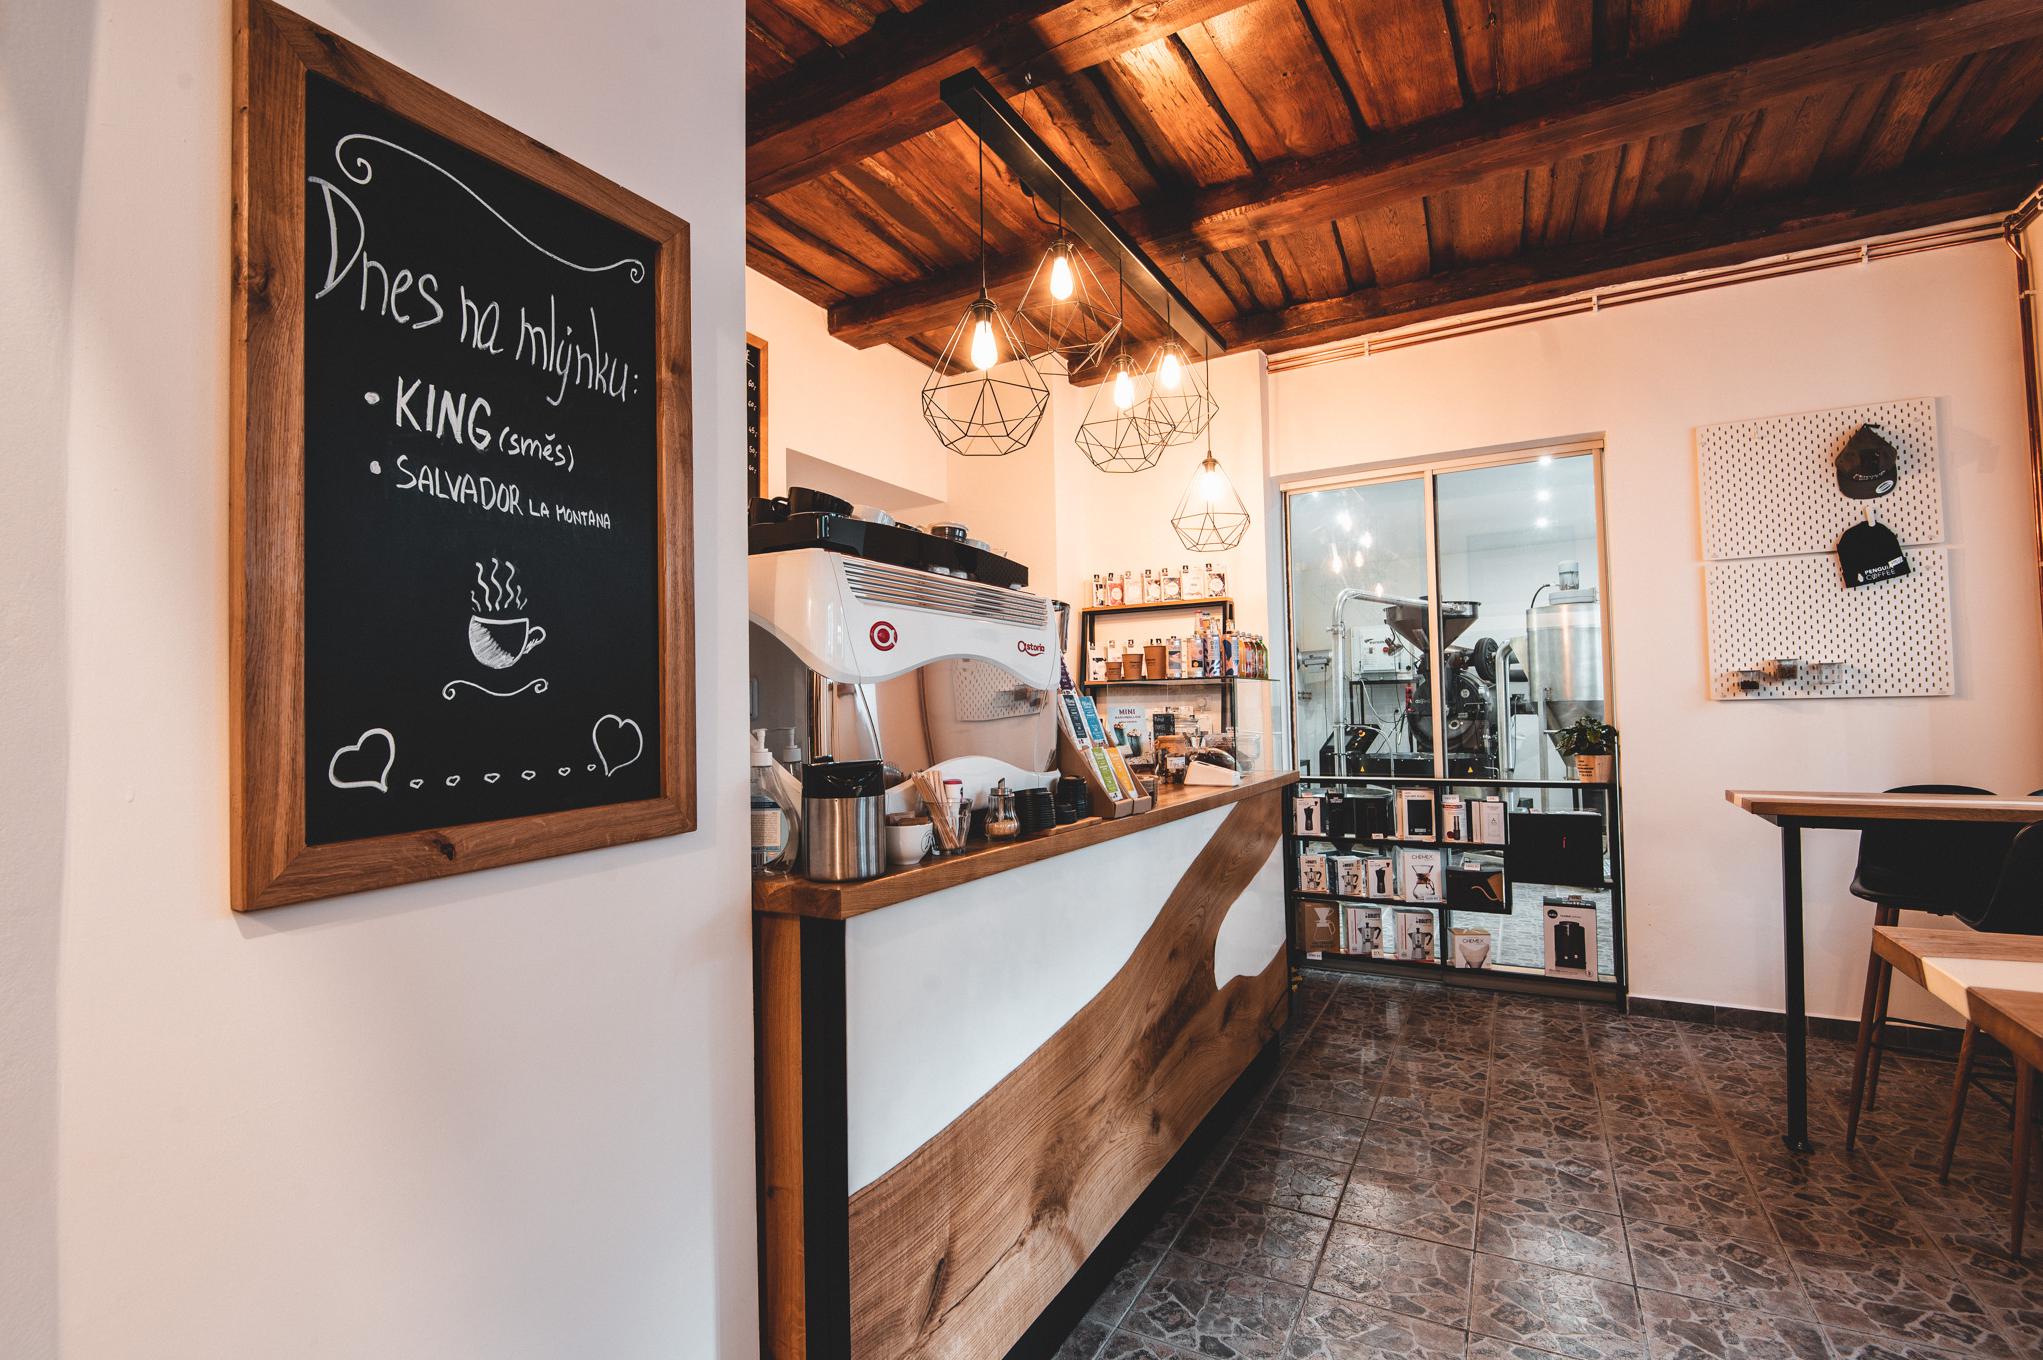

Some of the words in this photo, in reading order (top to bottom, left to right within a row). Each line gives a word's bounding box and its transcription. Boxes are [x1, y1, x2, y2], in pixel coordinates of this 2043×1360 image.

[308, 176, 443, 330] Dnes
[460, 285, 503, 355] na
[396, 376, 492, 450] KING
[498, 427, 575, 473] (směs)
[396, 455, 524, 516] SALVADOR
[529, 498, 550, 518] LA
[555, 504, 611, 530] MONTANA
[1119, 708, 1136, 716] MINI
